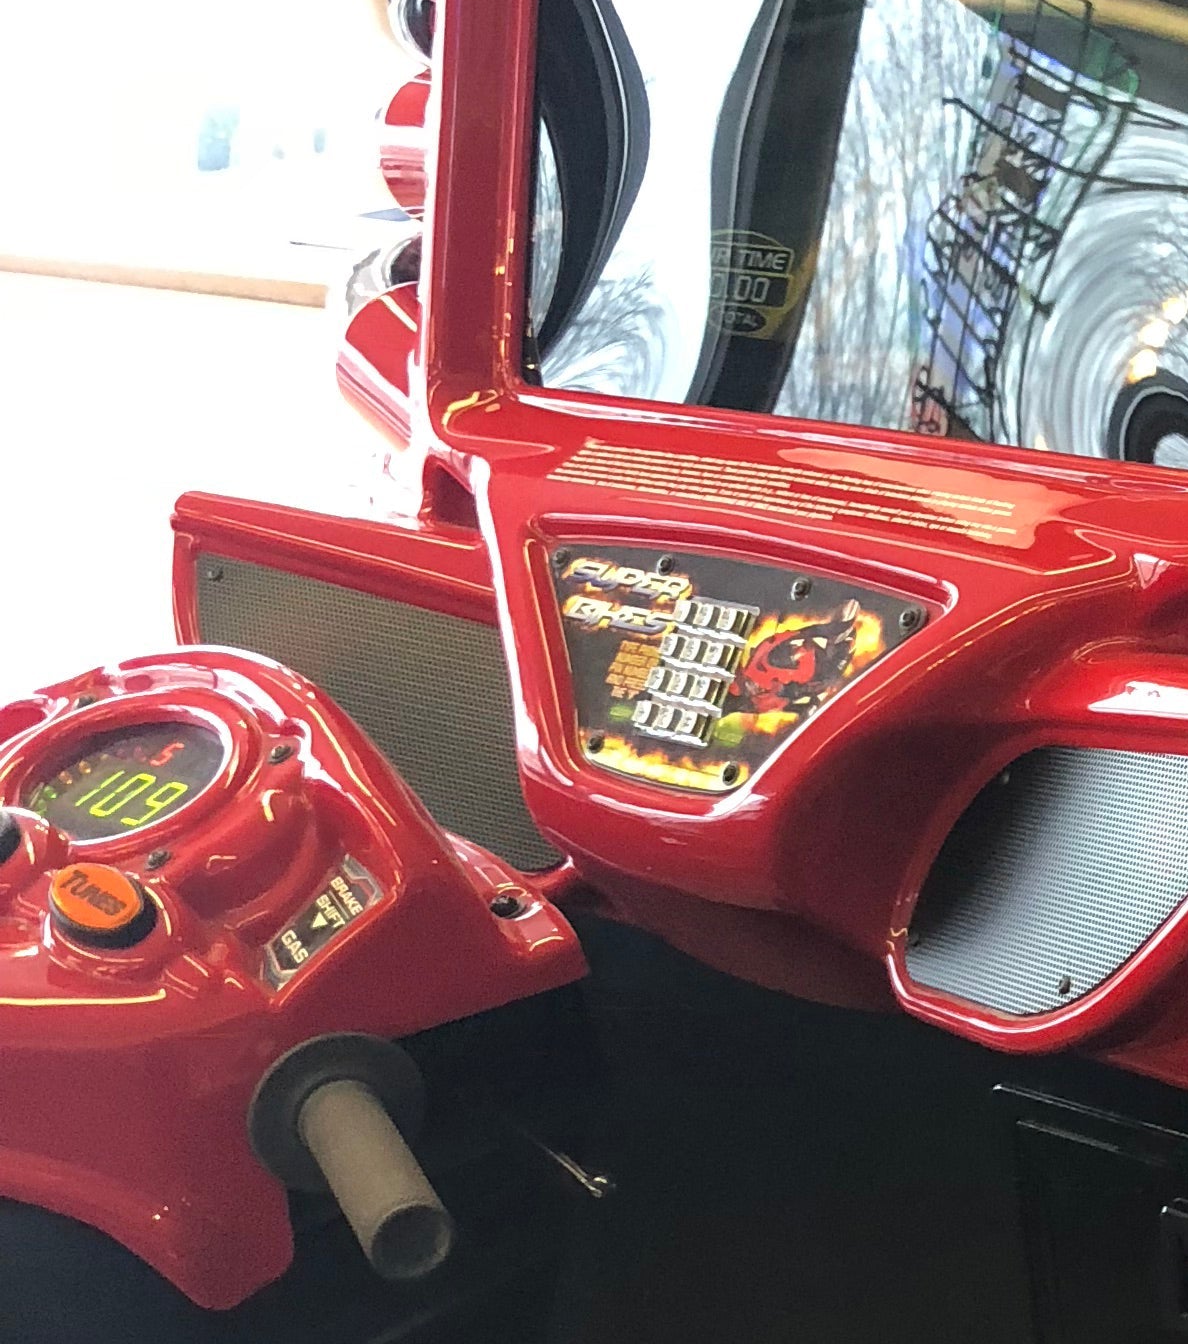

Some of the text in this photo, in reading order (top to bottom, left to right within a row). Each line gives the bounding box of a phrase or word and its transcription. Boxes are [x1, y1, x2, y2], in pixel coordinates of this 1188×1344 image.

[738, 249, 788, 270] TIME
[570, 563, 691, 600] SUPER
[565, 596, 676, 634] BIKES
[74, 770, 188, 826] 109
[316, 894, 346, 928] SHIFT
[330, 876, 364, 916] BRAKE
[281, 929, 309, 964] GAS
